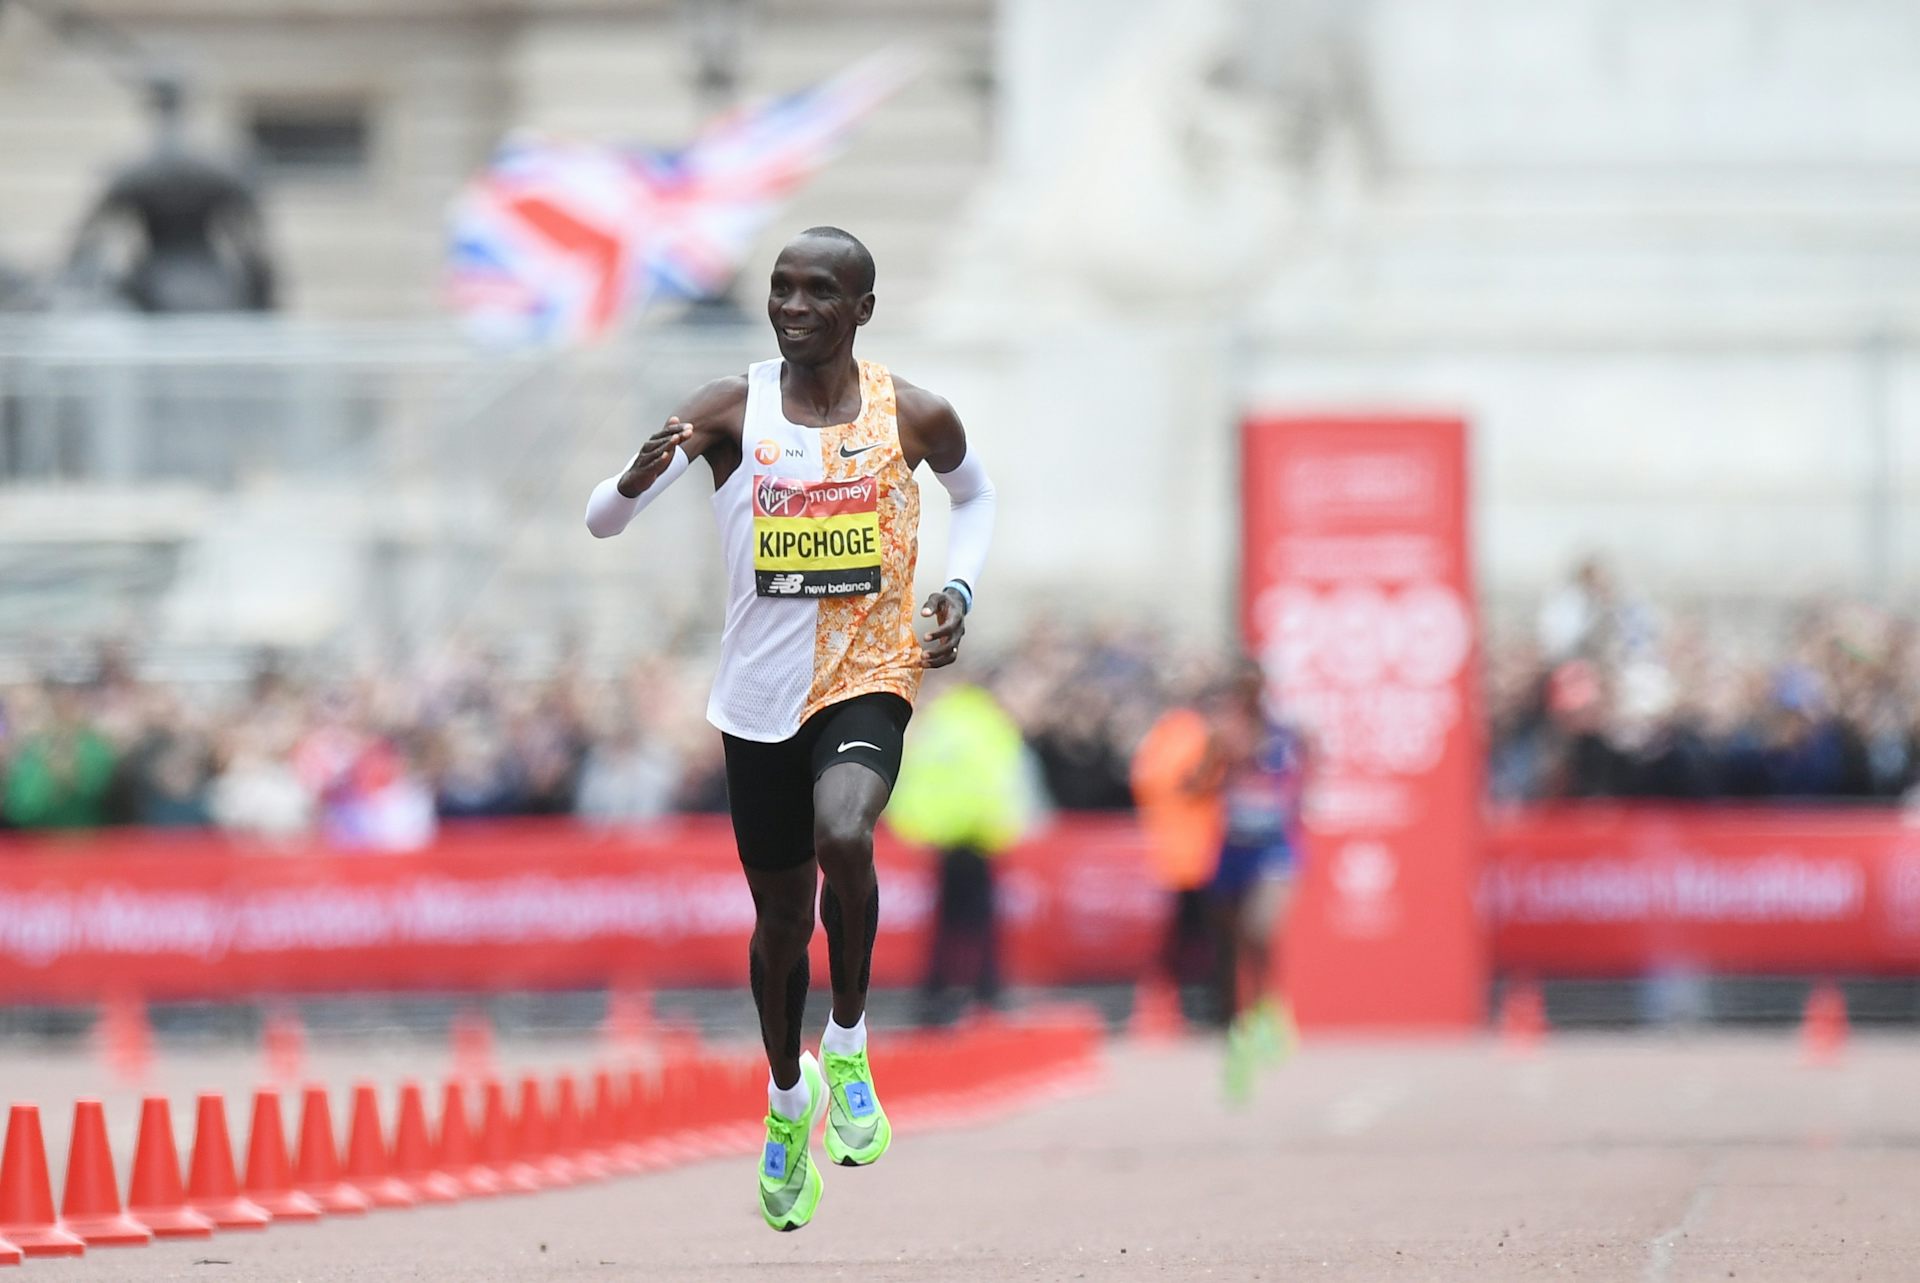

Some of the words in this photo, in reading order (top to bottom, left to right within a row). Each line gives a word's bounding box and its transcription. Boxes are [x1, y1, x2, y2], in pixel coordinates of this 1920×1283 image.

[785, 448, 804, 458] NN
[760, 476, 803, 515] Virgin
[809, 485, 873, 503] money
[759, 527, 876, 558] KIPCHOGE
[804, 585, 827, 595] new
[828, 581, 872, 594] balance
